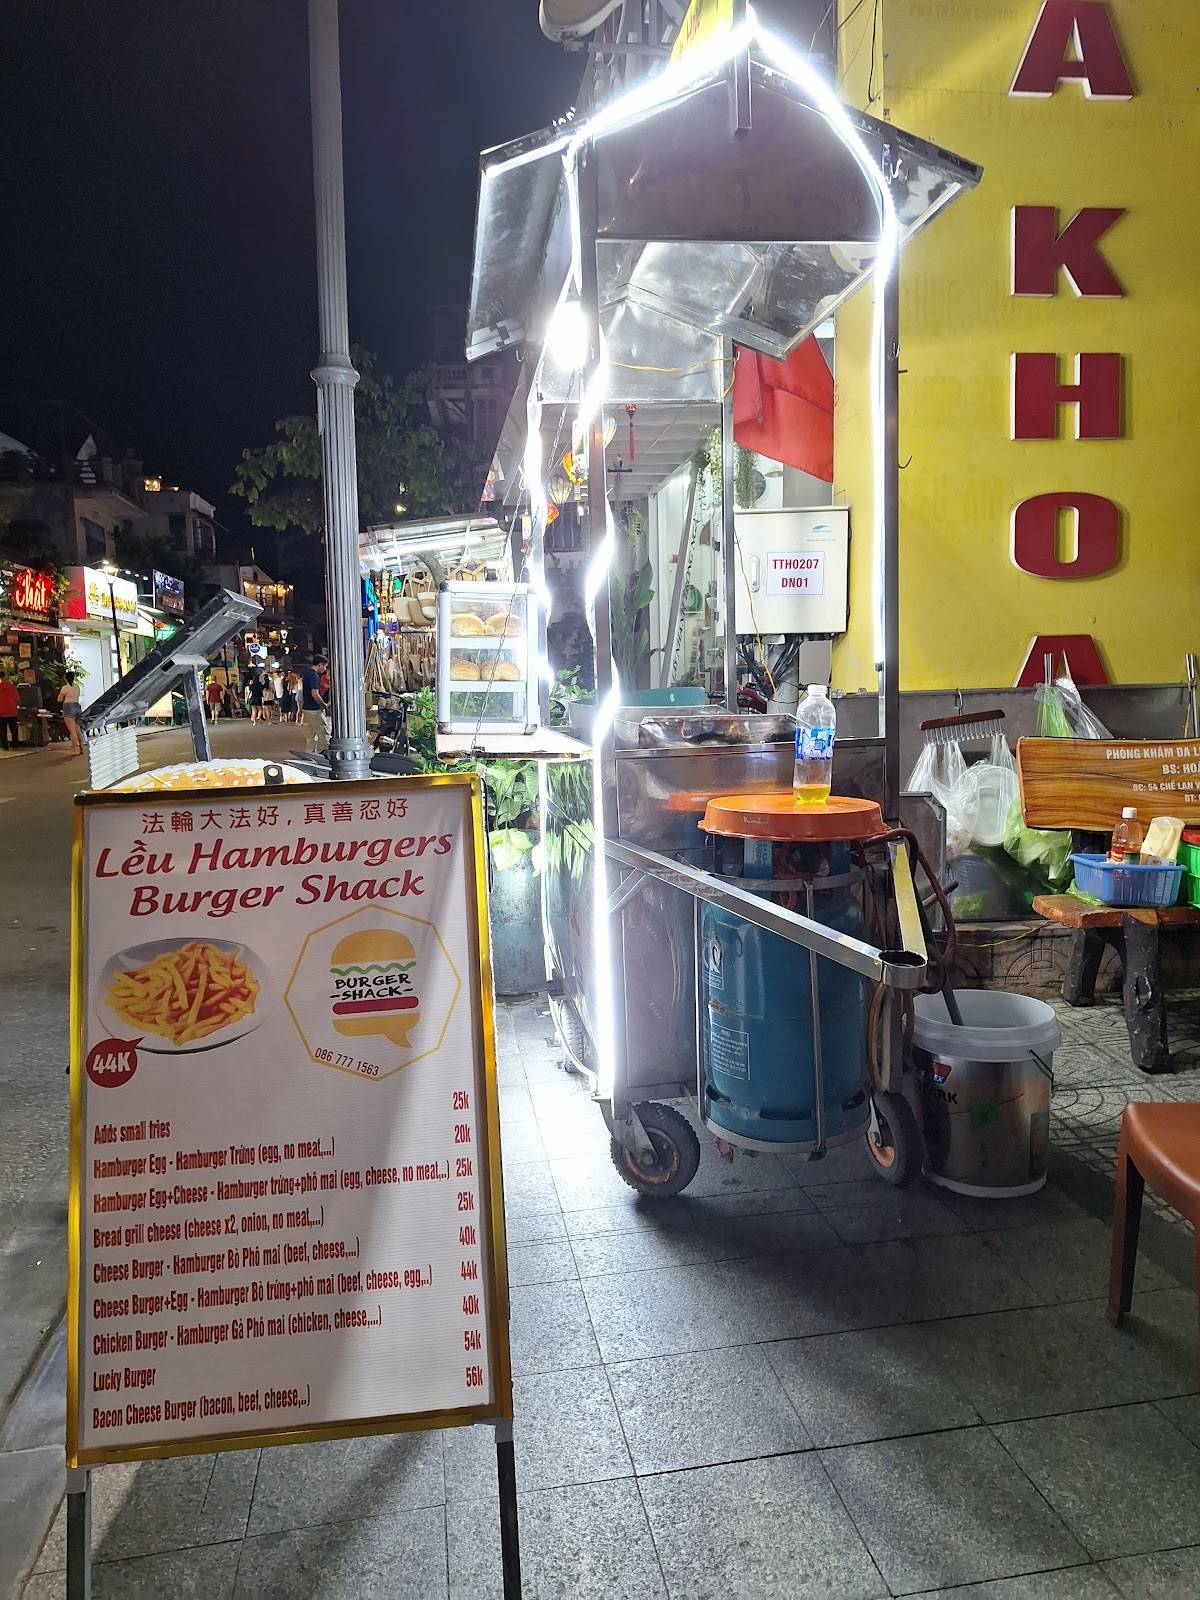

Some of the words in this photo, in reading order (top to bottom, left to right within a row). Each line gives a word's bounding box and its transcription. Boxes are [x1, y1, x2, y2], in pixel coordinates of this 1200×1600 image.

[772, 558, 820, 570] TTH0207
[782, 578, 809, 588] DN01
[96, 840, 176, 878] Lều
[187, 834, 453, 875] Hamburgers
[130, 885, 284, 918] Burger
[296, 870, 425, 905] Shack
[334, 973, 412, 990] BURGER
[92, 1052, 130, 1074] 44K
[314, 1048, 332, 1062] 086
[336, 1053, 354, 1069] 777
[356, 1060, 380, 1077] 1563
[453, 1090, 469, 1110] 25k
[94, 1124, 118, 1144] Adds
[120, 1120, 146, 1142] small
[149, 1120, 171, 1139] fries
[454, 1124, 471, 1144] 20k
[94, 1157, 146, 1178] Hamburger
[149, 1154, 166, 1174] Egg
[176, 1149, 228, 1170] Hamburger
[284, 1144, 295, 1160] no
[456, 1157, 472, 1177] 25k
[94, 1192, 146, 1214] Hamburger
[149, 1185, 208, 1209] Egg+Cheese
[217, 1180, 268, 1200] Hamburger
[320, 1170, 338, 1190] mai
[402, 1166, 414, 1182] no
[457, 1191, 474, 1211] 25k
[94, 1225, 122, 1249] Bread
[124, 1223, 144, 1248] grill
[147, 1222, 182, 1242] cheese
[242, 1212, 270, 1233] onion,
[272, 1212, 284, 1230] no
[459, 1225, 476, 1246] 40k
[93, 1263, 129, 1284] Cheese
[132, 1258, 164, 1280] Burger
[173, 1252, 225, 1275] Hamburger
[263, 1244, 281, 1266] mai
[460, 1260, 478, 1280] 44k
[93, 1298, 129, 1320] Cheese
[132, 1290, 188, 1316] Burger+Egg
[198, 1285, 250, 1308] Hamburger
[317, 1273, 335, 1296] mai
[462, 1294, 480, 1315] 40k
[93, 1331, 132, 1356] Chicken
[136, 1330, 168, 1351] Burger
[176, 1324, 230, 1346] Hamburger
[268, 1314, 285, 1336] mai
[464, 1330, 482, 1351] 54k
[93, 1368, 122, 1392] Lucky
[124, 1367, 156, 1390] Burger
[466, 1366, 484, 1388] 56k
[92, 1406, 123, 1430] Bacon
[126, 1404, 162, 1426] Cheese
[164, 1400, 197, 1422] Burger
